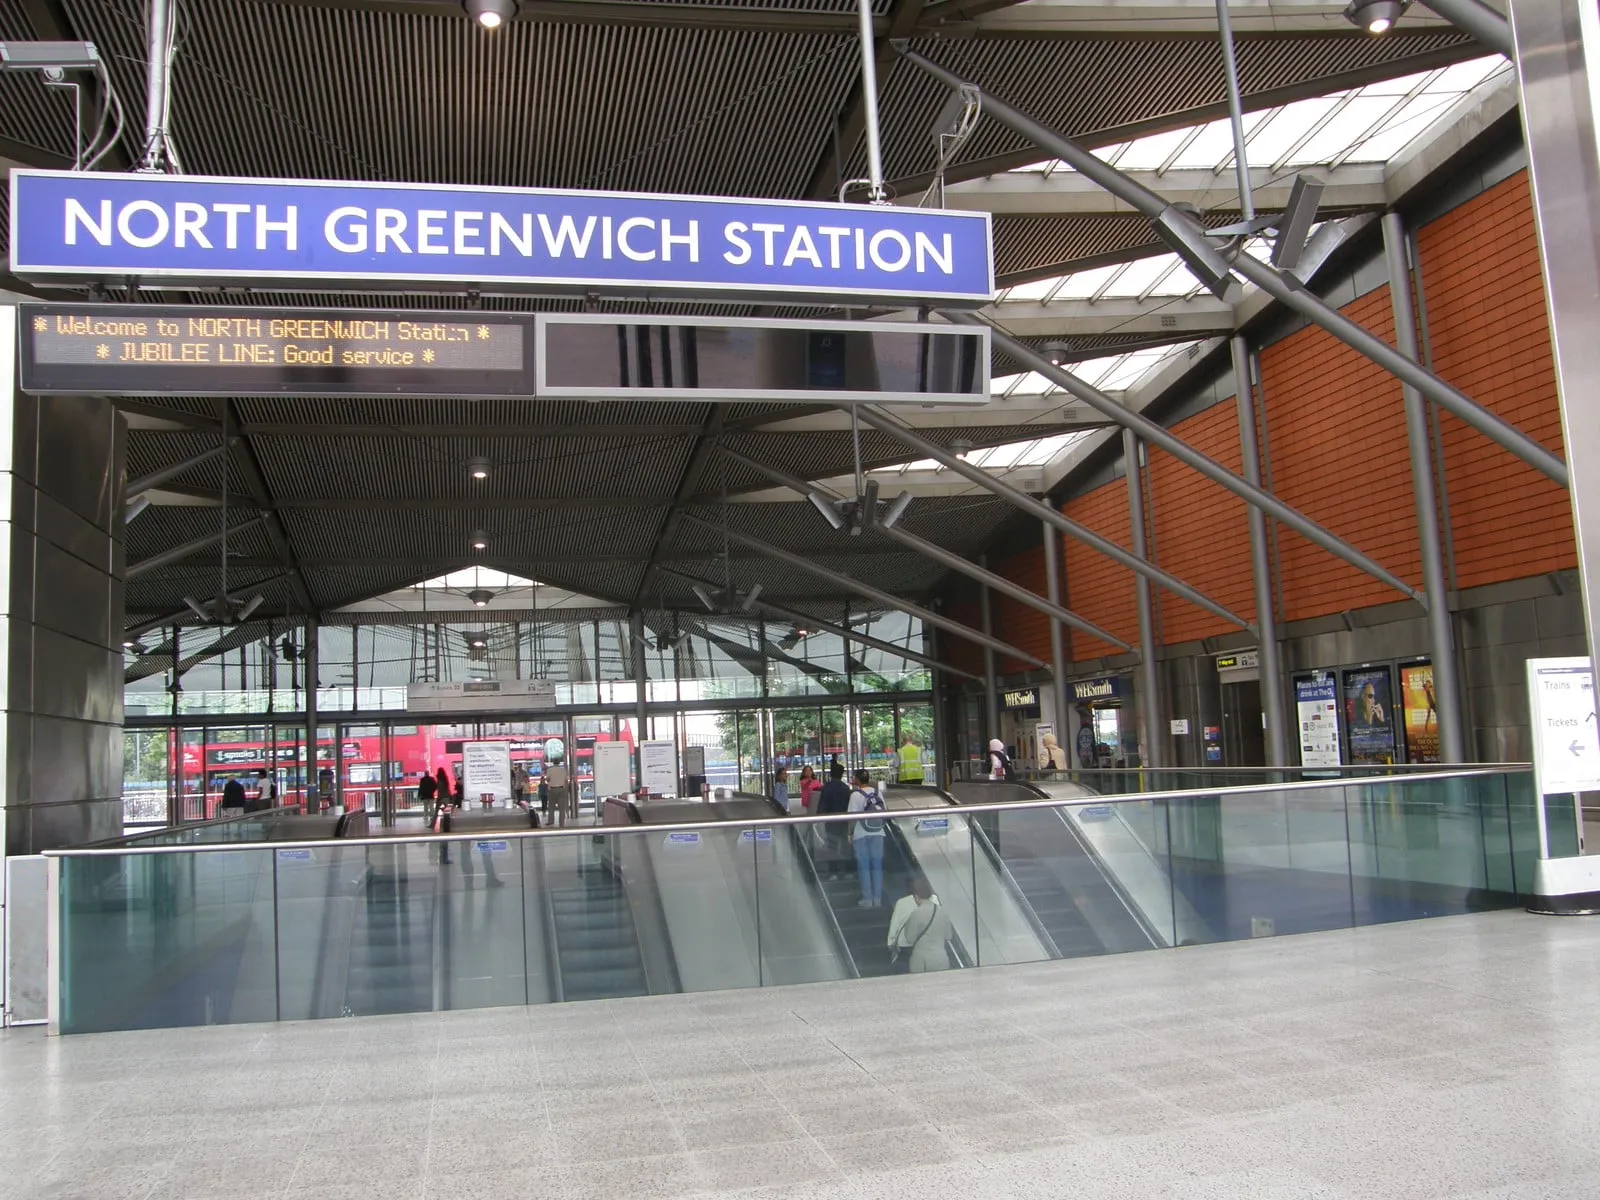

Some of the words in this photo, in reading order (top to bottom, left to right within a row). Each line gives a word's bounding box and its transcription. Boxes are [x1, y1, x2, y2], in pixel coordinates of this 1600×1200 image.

[64, 198, 298, 251] NORTH
[324, 206, 700, 263] GREENWICH
[723, 222, 955, 275] STATION
[56, 316, 148, 336] Welcome
[156, 319, 180, 337] to
[188, 318, 261, 337] NORTH
[269, 319, 389, 340] GREENWICH
[119, 343, 209, 362] JUBILEE
[218, 344, 275, 363] LINE:
[284, 345, 333, 364] Good
[342, 348, 414, 365] service
[1074, 679, 1112, 698] WHSmith
[1544, 680, 1571, 690] Trains
[1005, 690, 1035, 707] WHSmith
[1547, 718, 1579, 728] Tickets
